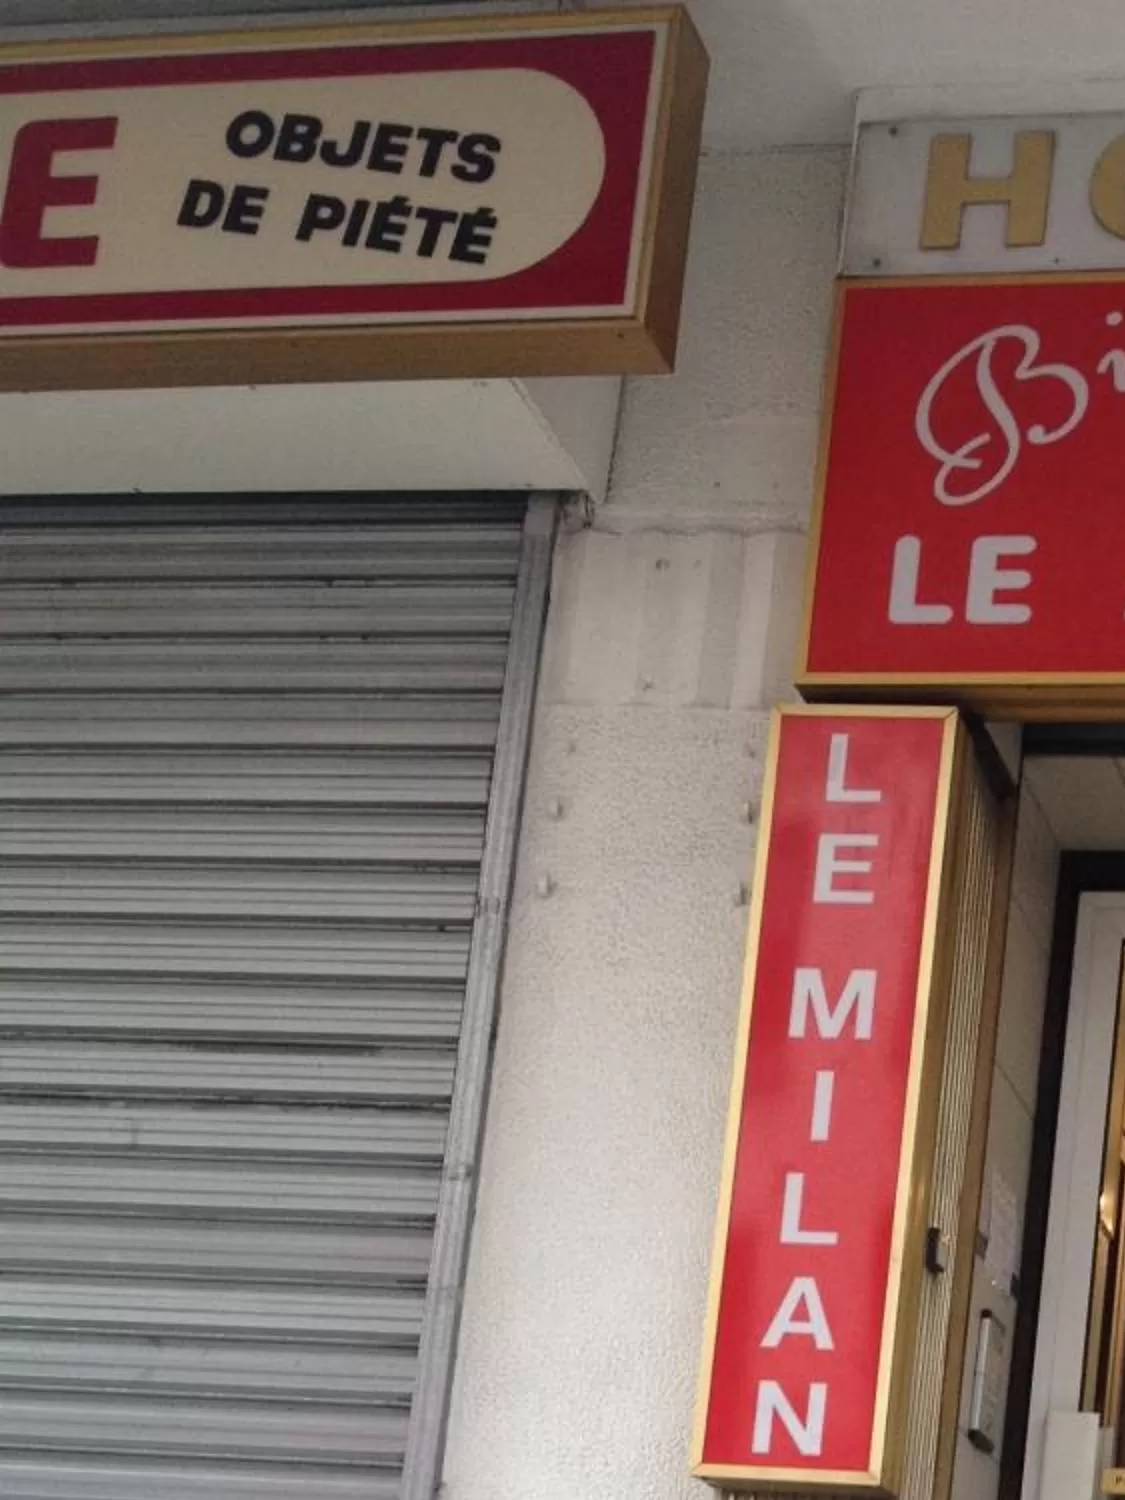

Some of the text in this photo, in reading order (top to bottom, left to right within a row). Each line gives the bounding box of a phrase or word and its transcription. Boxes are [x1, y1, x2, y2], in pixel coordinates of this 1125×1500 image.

[225, 109, 501, 185] OBJETS
[177, 179, 498, 265] DE PIÉTÉ
[887, 534, 1038, 626] LE
